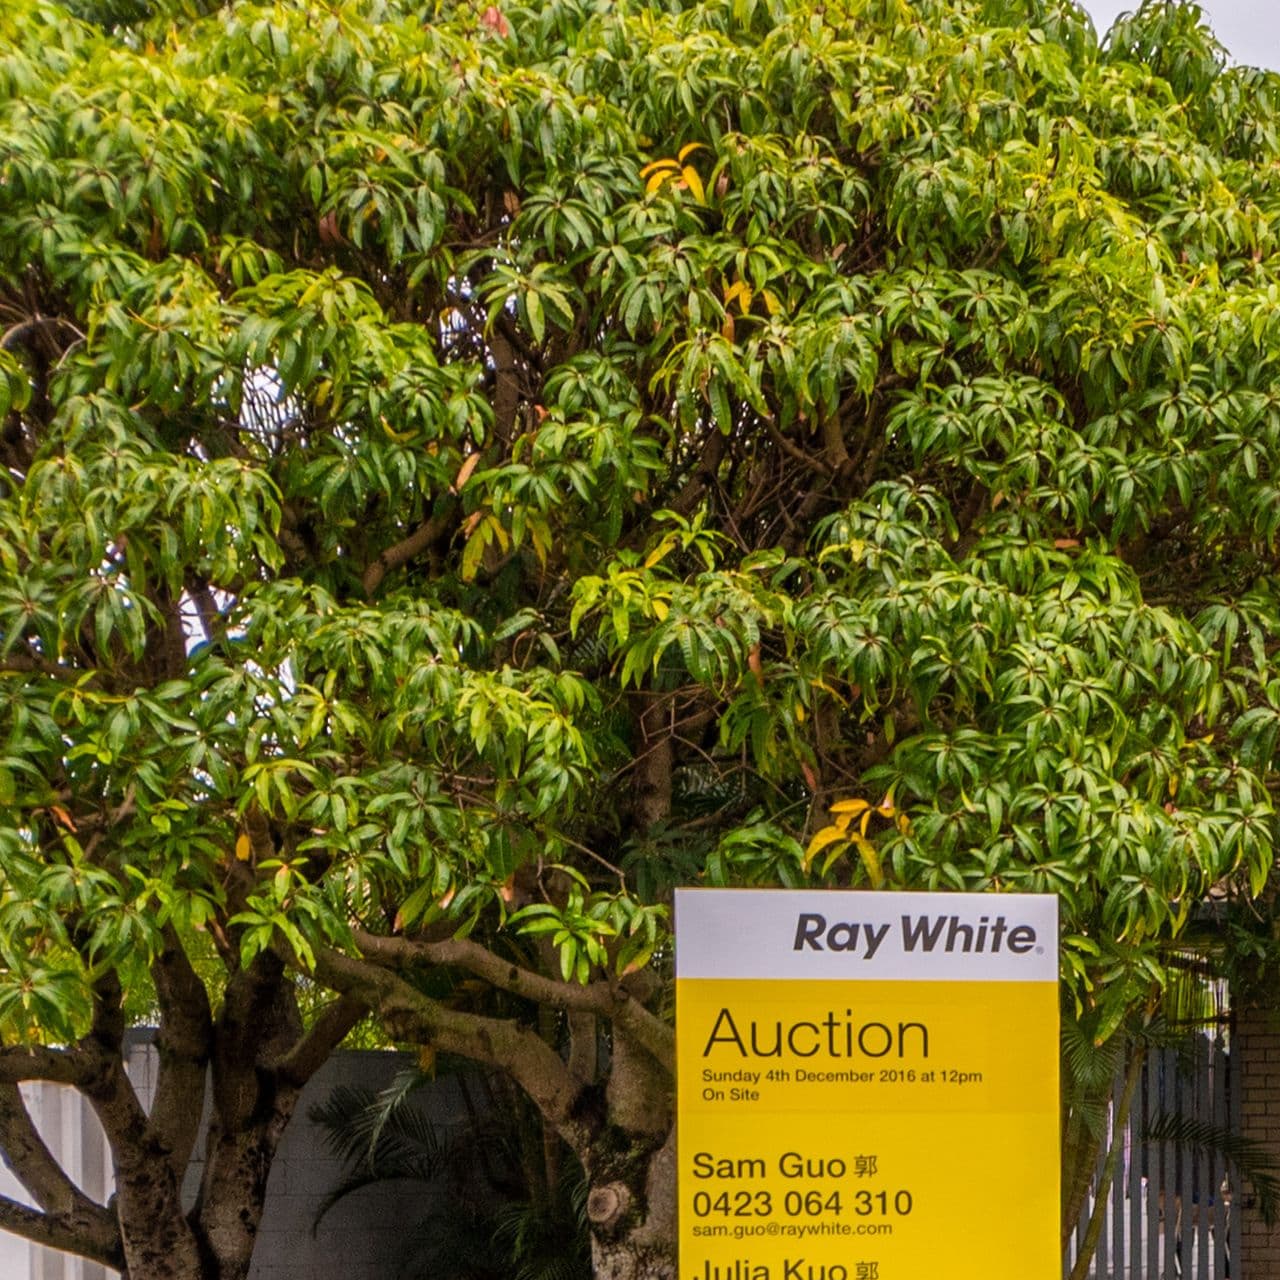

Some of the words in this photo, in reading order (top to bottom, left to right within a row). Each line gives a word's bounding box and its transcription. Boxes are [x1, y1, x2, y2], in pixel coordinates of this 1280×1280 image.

[793, 913, 891, 959] Ray
[901, 915, 1037, 953] White
[703, 1008, 929, 1058] Auction
[703, 1069, 760, 1085] Sunday
[766, 1069, 790, 1082] 4th
[796, 1069, 875, 1082] December
[880, 1070, 916, 1082] 2016
[921, 1071, 935, 1082] at
[941, 1070, 983, 1085] 12pm
[703, 1088, 724, 1101] On
[730, 1088, 760, 1101] Site
[693, 1152, 766, 1179] Sam
[779, 1152, 847, 1178] Guo
[854, 1154, 878, 1178] 郭
[693, 1191, 773, 1217] 0423
[784, 1191, 843, 1216] 064
[855, 1190, 913, 1216] 310
[692, 1222, 893, 1239] sam.guo@raywhite.com
